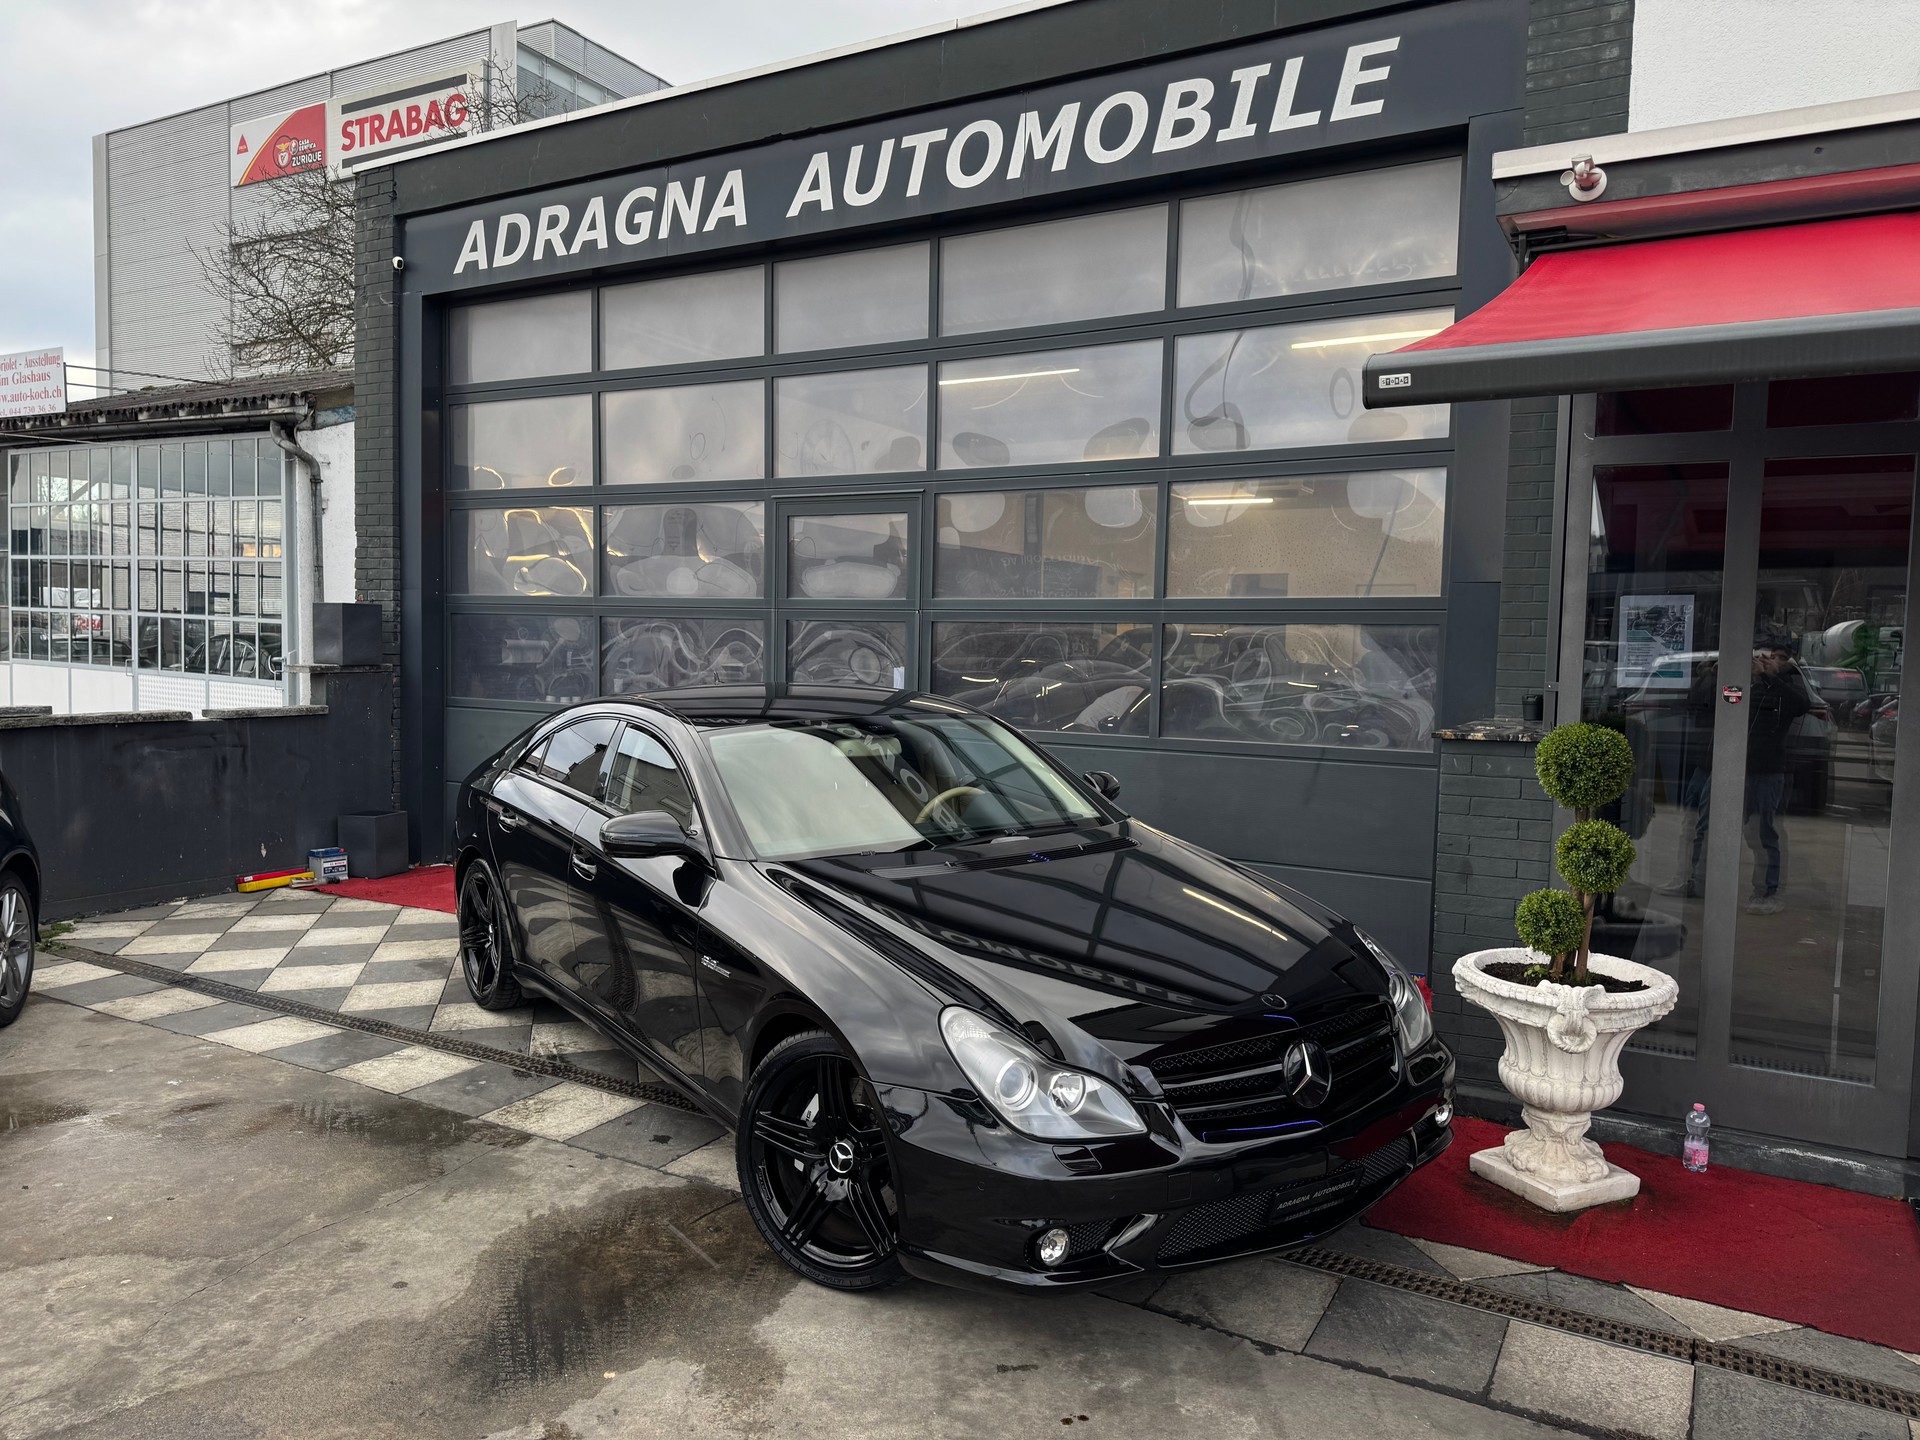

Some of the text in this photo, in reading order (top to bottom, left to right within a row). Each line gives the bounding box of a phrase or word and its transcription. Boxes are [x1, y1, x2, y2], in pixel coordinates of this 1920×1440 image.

[341, 93, 468, 151] STRABAG
[292, 150, 322, 167] ZURIQUE
[453, 36, 1400, 275] ADRAGNA AUTOMOBILE
[24, 352, 61, 368] Ausstellung
[12, 370, 51, 385] Glashaus
[9, 407, 21, 415] 044
[23, 405, 35, 414] 730
[37, 404, 46, 413] 36
[47, 403, 57, 412] 36
[1277, 1178, 1357, 1210] ADRAGNA AUTOMOBILE
